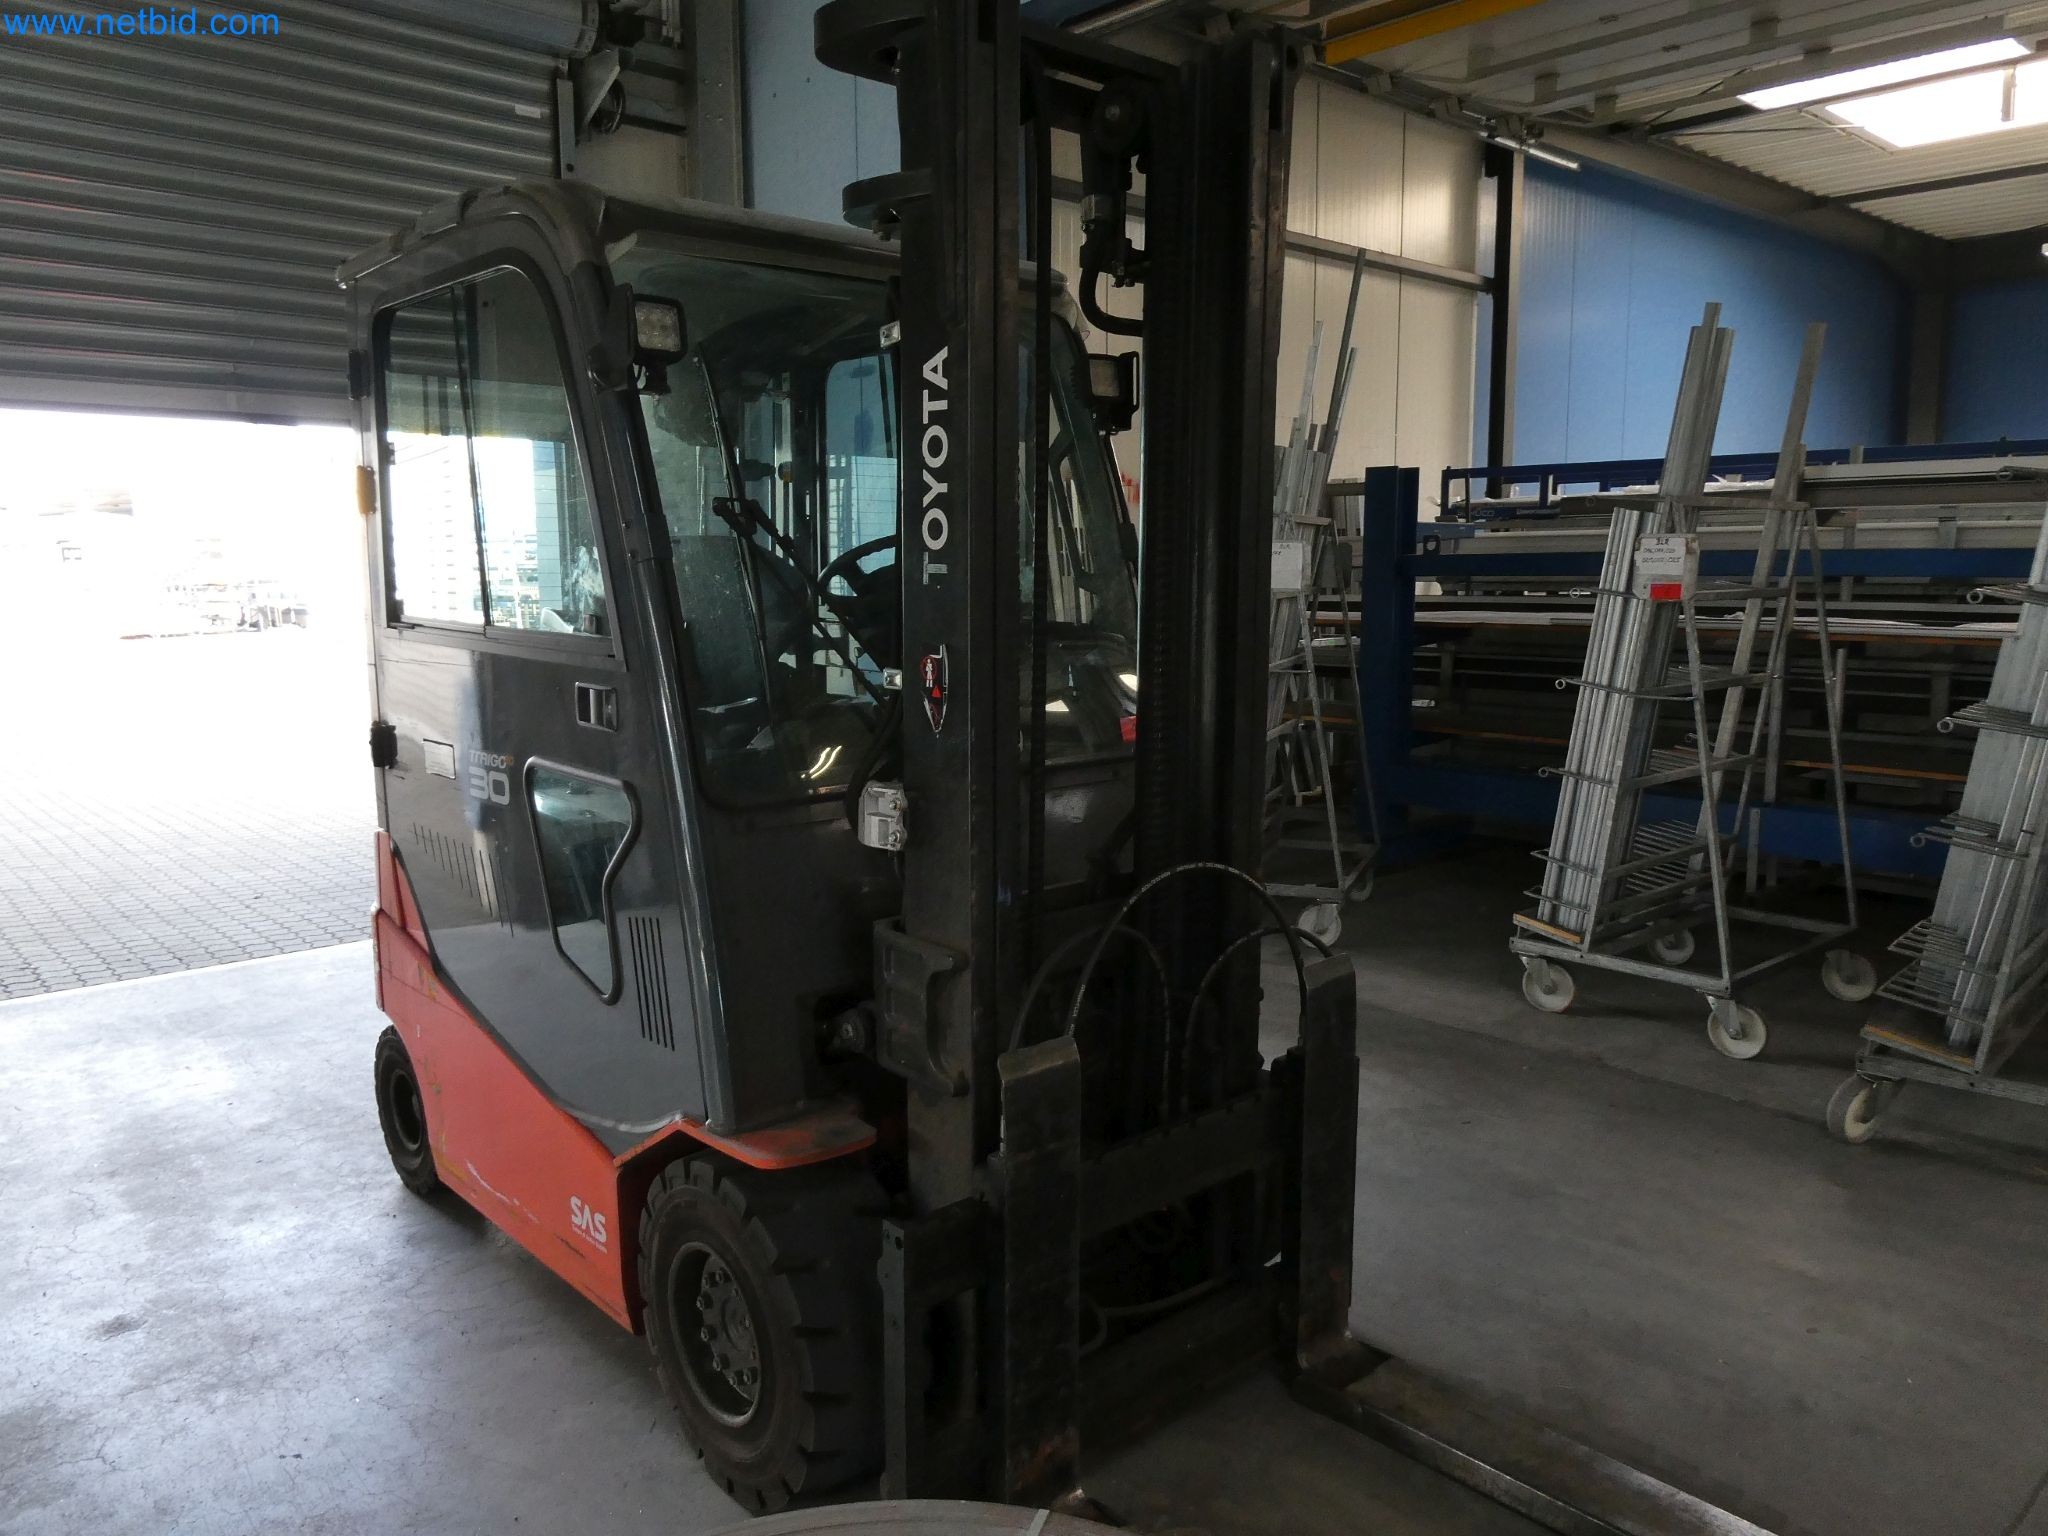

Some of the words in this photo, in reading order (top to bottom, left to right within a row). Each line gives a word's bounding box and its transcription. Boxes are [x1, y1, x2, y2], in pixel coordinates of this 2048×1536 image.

[922, 346, 949, 585] TOYOTA
[468, 765, 510, 806] 30
[570, 1195, 607, 1243] SAS
